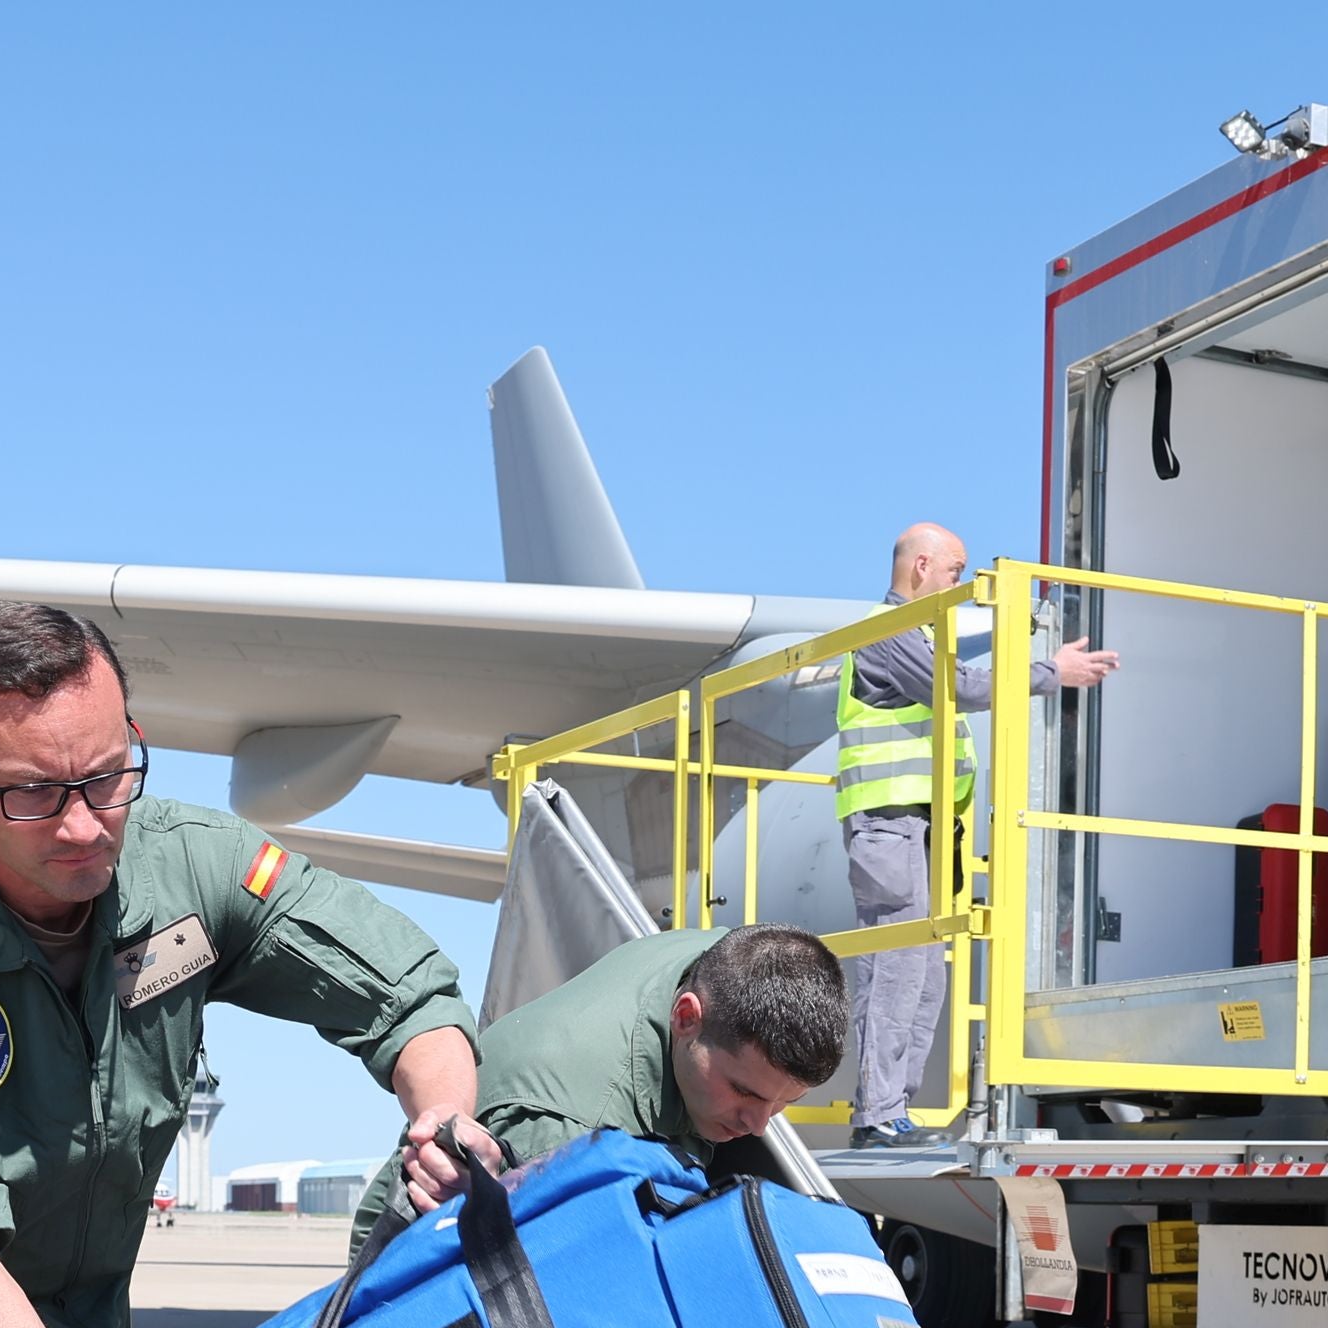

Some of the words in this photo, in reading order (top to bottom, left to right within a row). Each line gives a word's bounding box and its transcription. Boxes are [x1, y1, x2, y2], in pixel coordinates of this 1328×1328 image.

[123, 971, 179, 1006] ROMERO
[181, 953, 212, 975] GUIA
[1253, 1288, 1267, 1308] By
